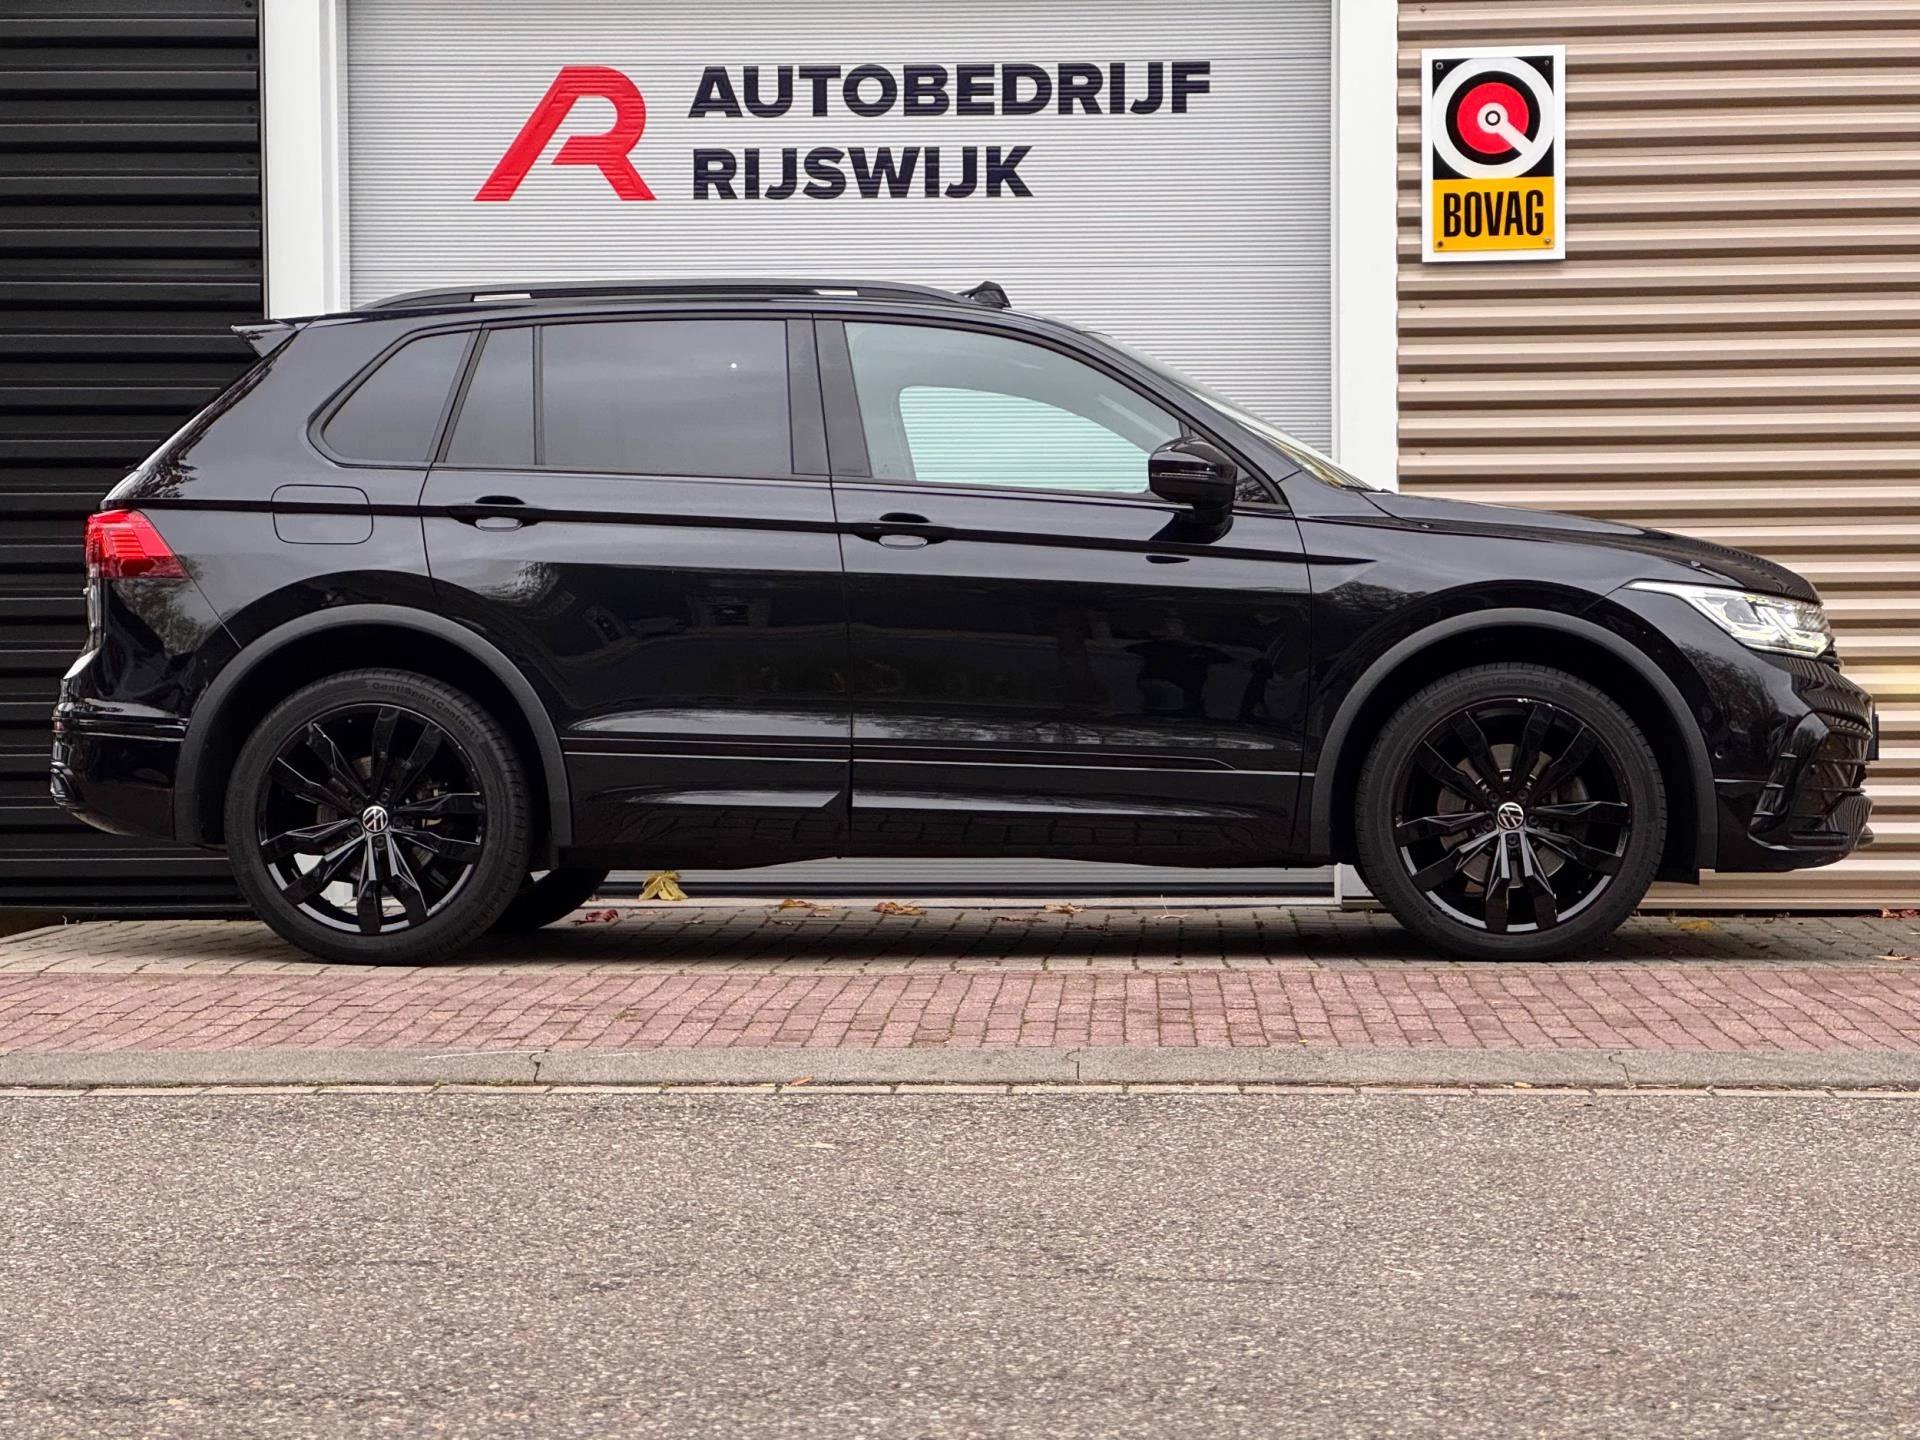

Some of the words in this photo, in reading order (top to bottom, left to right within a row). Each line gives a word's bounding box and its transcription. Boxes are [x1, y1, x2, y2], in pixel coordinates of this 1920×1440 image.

[688, 61, 1211, 118] AUTOBEDRIJF
[693, 145, 1034, 200] RIJSWIJK
[1443, 189, 1544, 238] BOVAG
